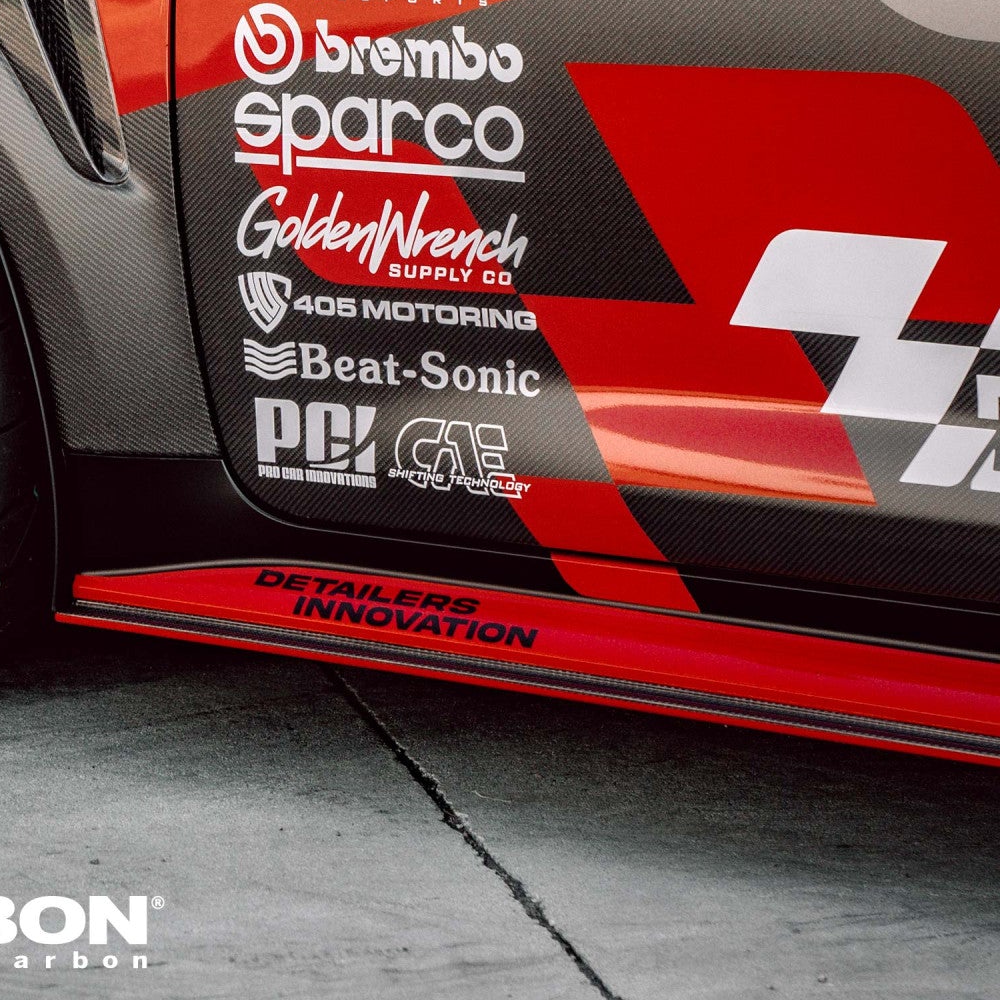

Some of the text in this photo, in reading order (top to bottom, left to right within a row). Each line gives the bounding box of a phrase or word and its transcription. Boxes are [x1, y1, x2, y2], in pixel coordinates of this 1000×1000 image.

[315, 19, 523, 83] brembo
[234, 92, 525, 178] sparco
[389, 264, 513, 286] SUPPLY CO
[293, 295, 537, 331] 405 MOTORING
[298, 342, 541, 398] Beat-Sonic
[255, 397, 377, 474] PCI
[387, 468, 532, 493] SHIFTING TECHNOLOGY
[254, 569, 481, 615] DETAILERS
[292, 595, 539, 649] INNOVATION
